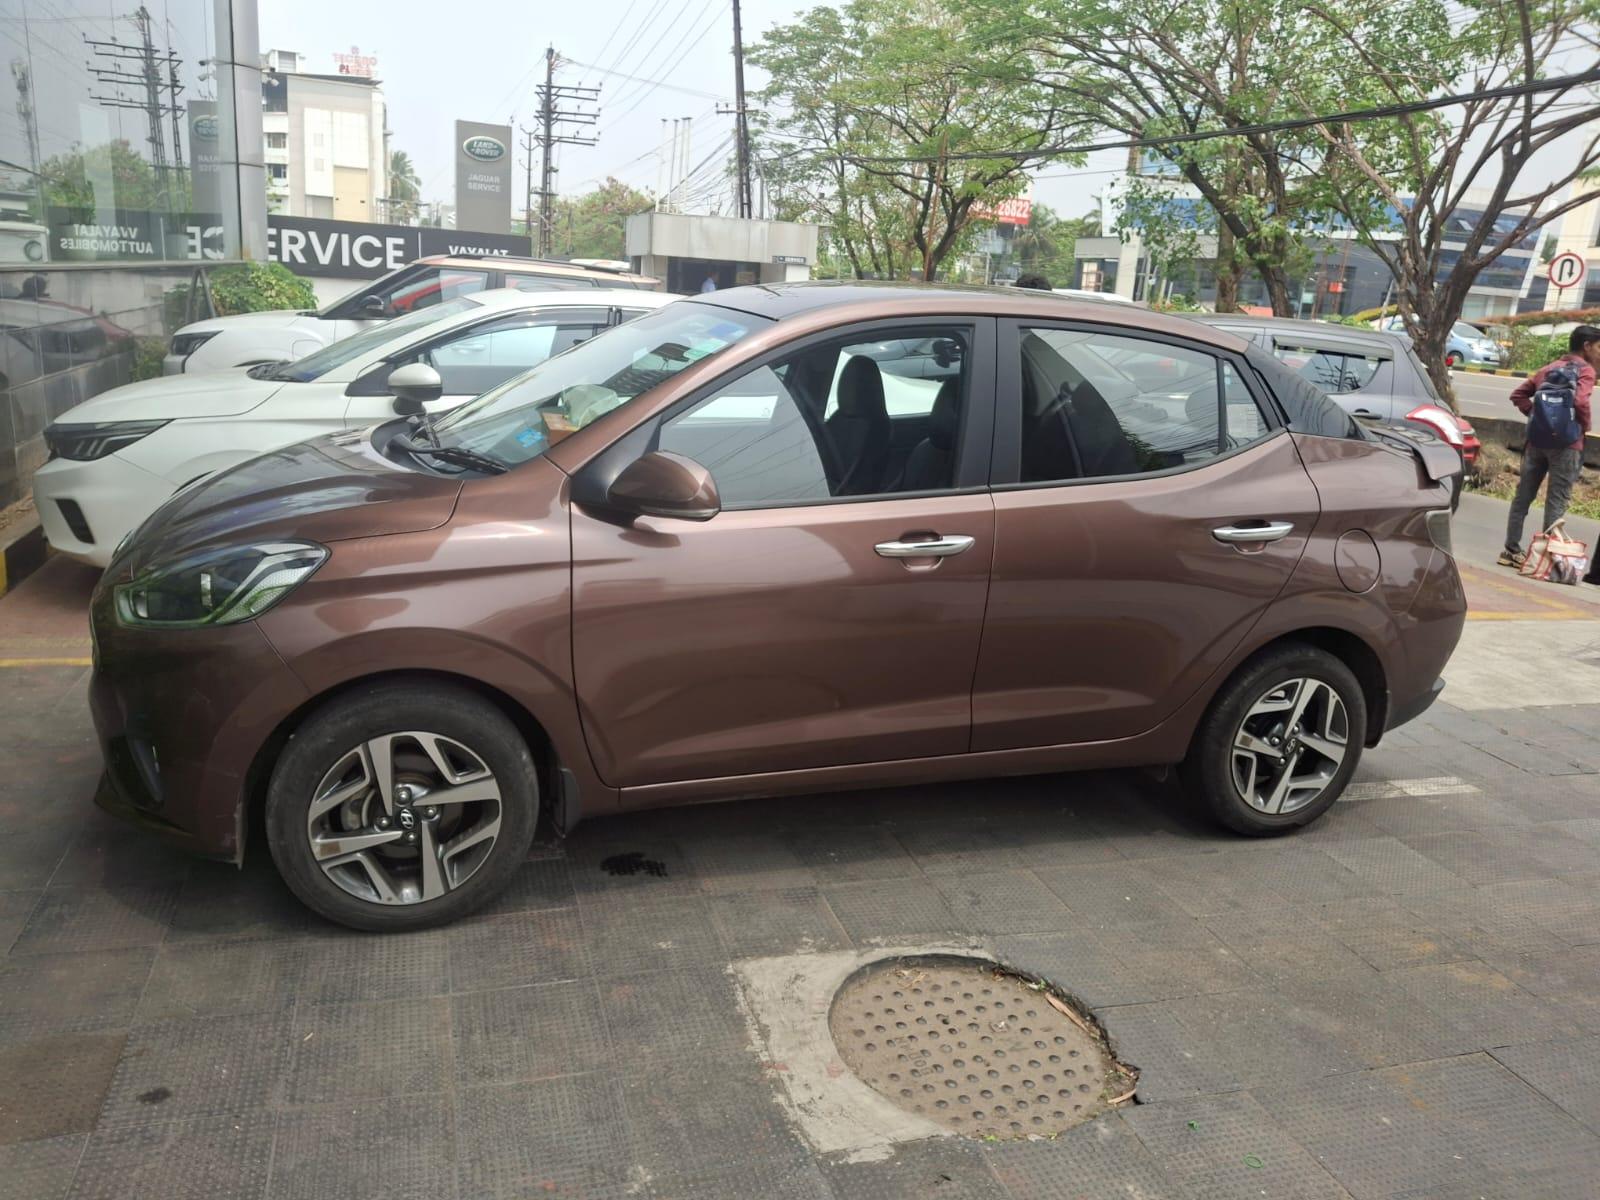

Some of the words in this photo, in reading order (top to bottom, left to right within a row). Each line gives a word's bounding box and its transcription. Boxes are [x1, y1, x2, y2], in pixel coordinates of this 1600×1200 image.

[473, 140, 494, 149] LAND
[475, 148, 500, 157] ROVER
[468, 174, 501, 184] JAGUAR
[467, 182, 502, 192] SERVICE
[267, 228, 406, 270] ERVICE
